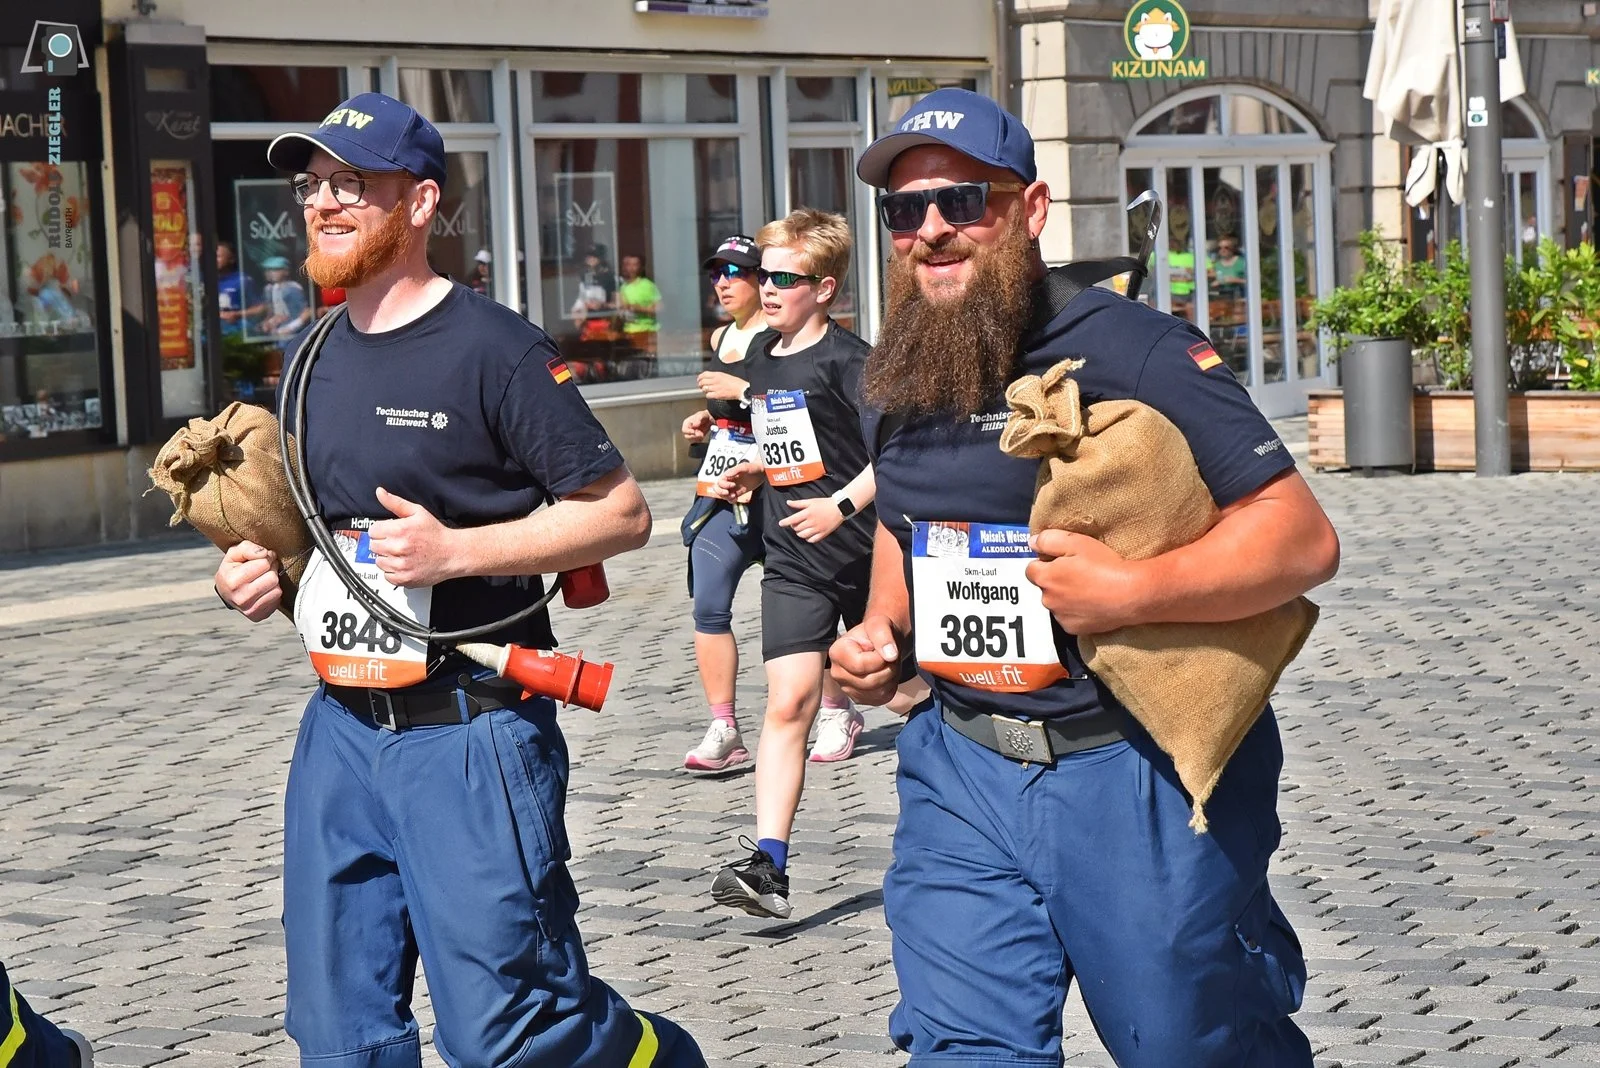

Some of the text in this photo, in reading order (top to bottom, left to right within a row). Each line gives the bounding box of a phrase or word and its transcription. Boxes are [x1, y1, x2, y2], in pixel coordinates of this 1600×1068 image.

[1112, 60, 1205, 78] KIZUNAM
[901, 110, 965, 130] THW
[375, 406, 430, 418] Technisches
[385, 416, 428, 428] Hilfswerk
[766, 425, 788, 436] Justus
[763, 440, 805, 466] 3316
[772, 466, 805, 482] well fit
[964, 568, 997, 576] 5km-Lauf
[946, 581, 1019, 605] Wolfgang
[321, 611, 402, 655] 3848
[940, 614, 1026, 658] 3851
[328, 663, 357, 679] well
[366, 659, 388, 681] fit
[959, 670, 997, 685] well
[1001, 664, 1028, 685] fit
